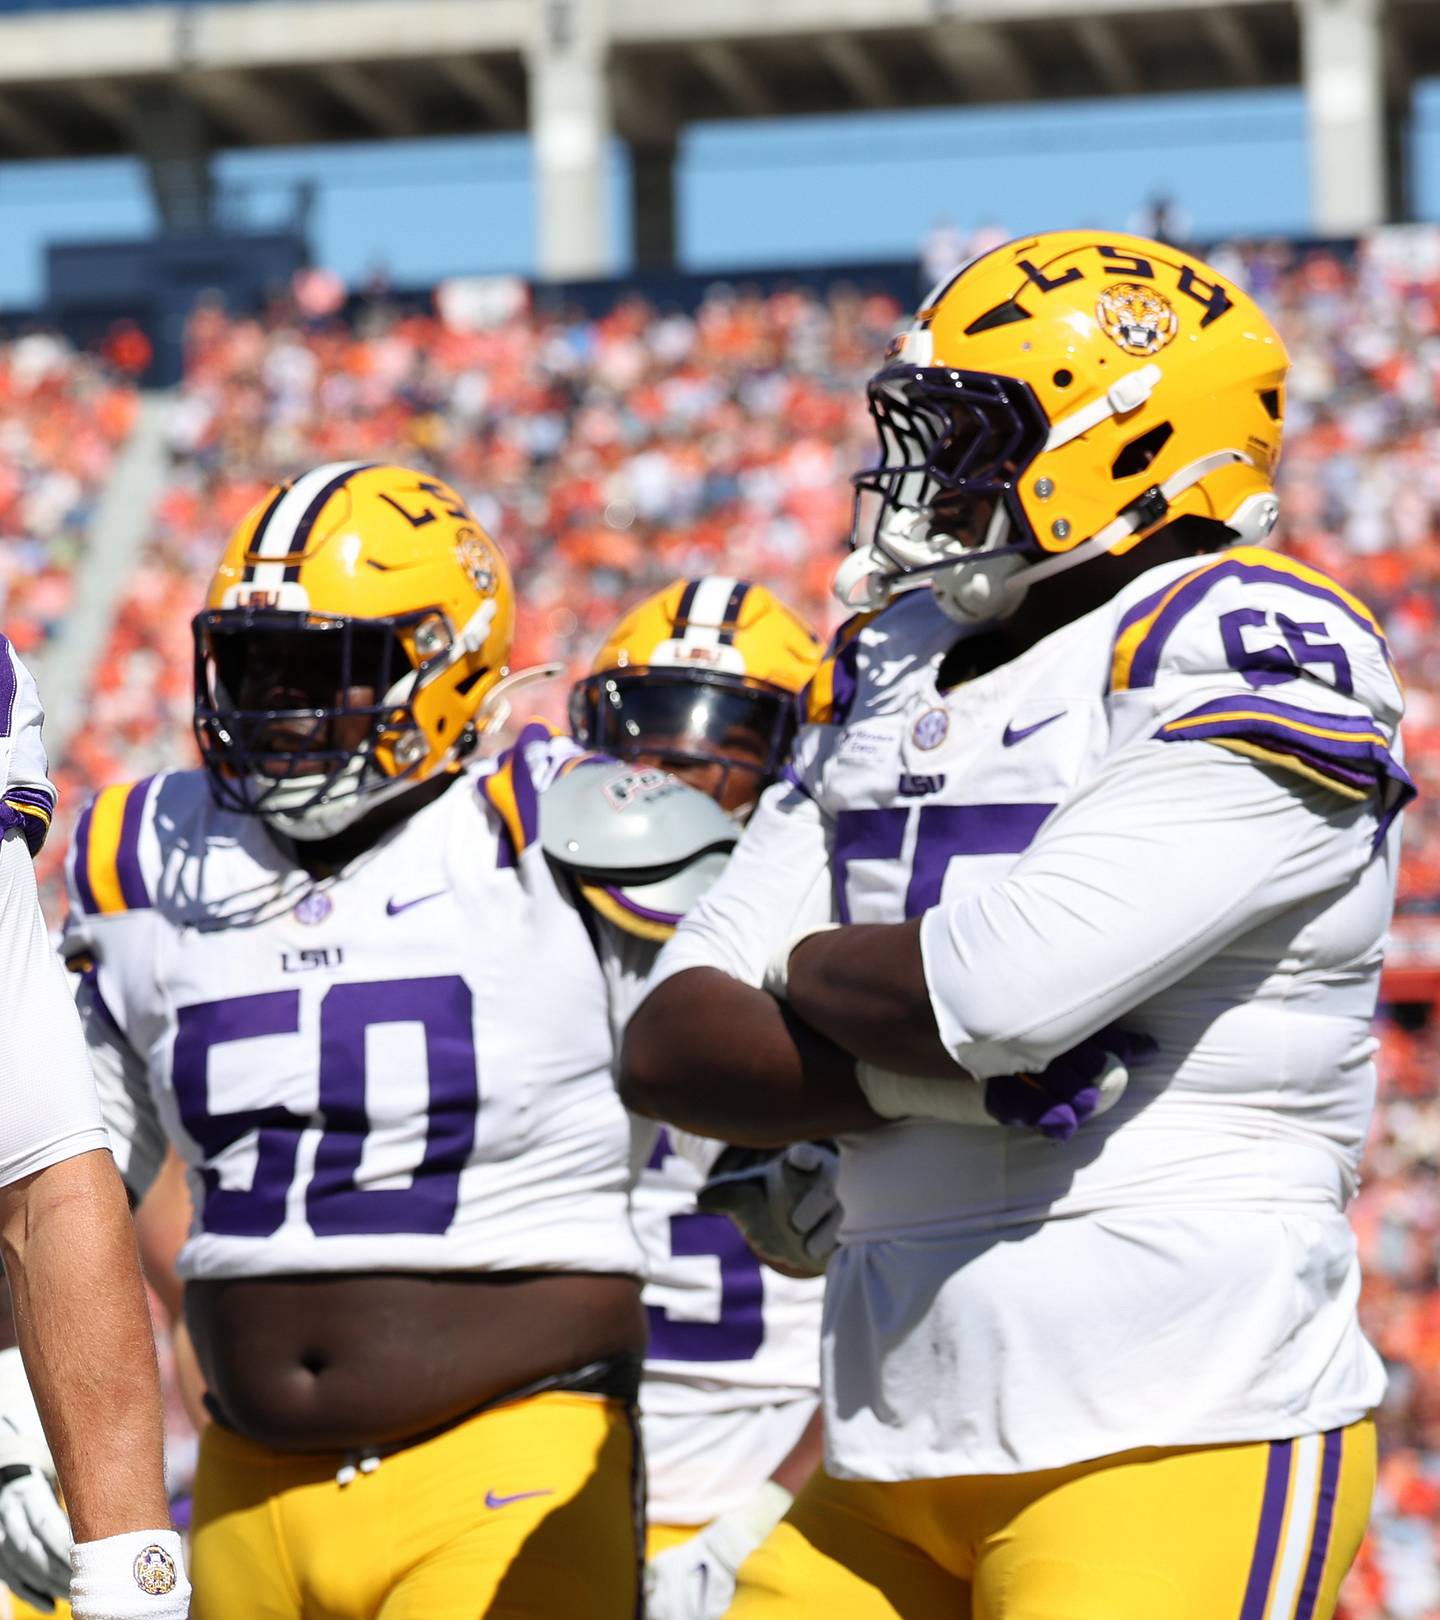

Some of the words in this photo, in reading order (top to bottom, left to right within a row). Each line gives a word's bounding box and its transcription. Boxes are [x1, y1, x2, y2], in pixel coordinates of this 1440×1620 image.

[1016, 246, 1234, 329] LSU
[379, 481, 469, 528] LS
[281, 948, 343, 972] LSU
[171, 975, 478, 1237] 50
